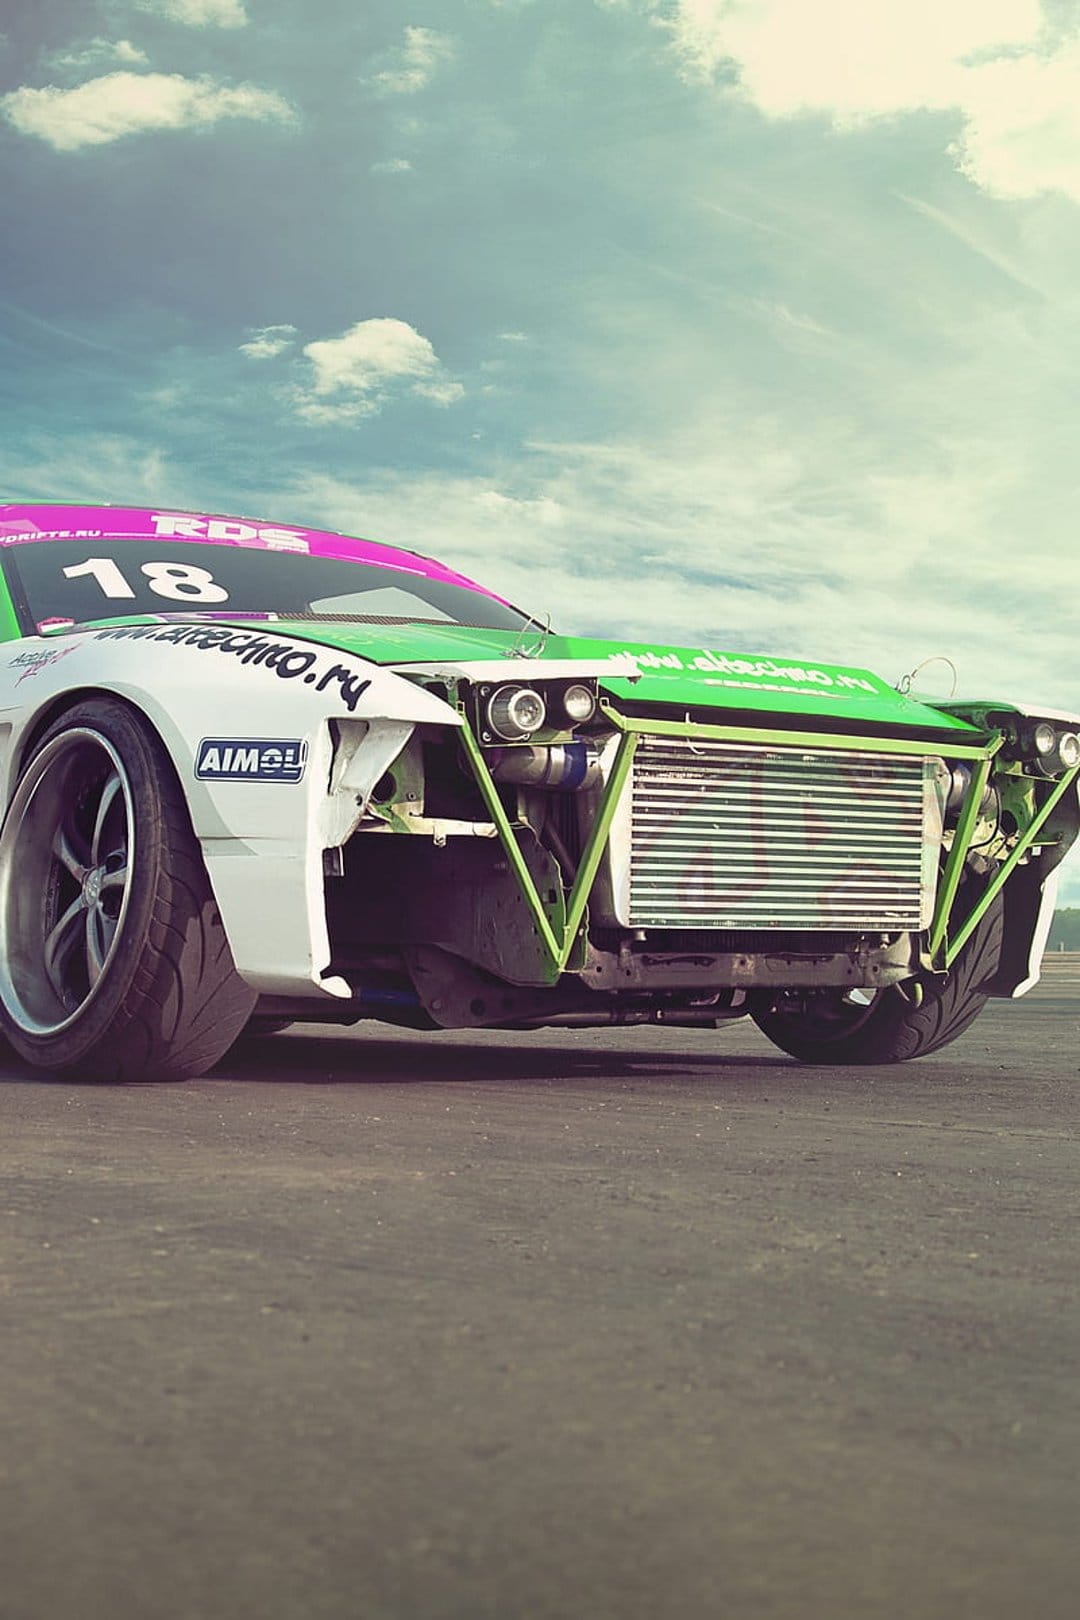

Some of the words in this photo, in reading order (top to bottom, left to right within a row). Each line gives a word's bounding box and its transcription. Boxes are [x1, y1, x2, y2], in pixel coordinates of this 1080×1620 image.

[151, 515, 310, 553] RDS
[62, 558, 229, 603] 18
[199, 747, 303, 774] AIMOL
